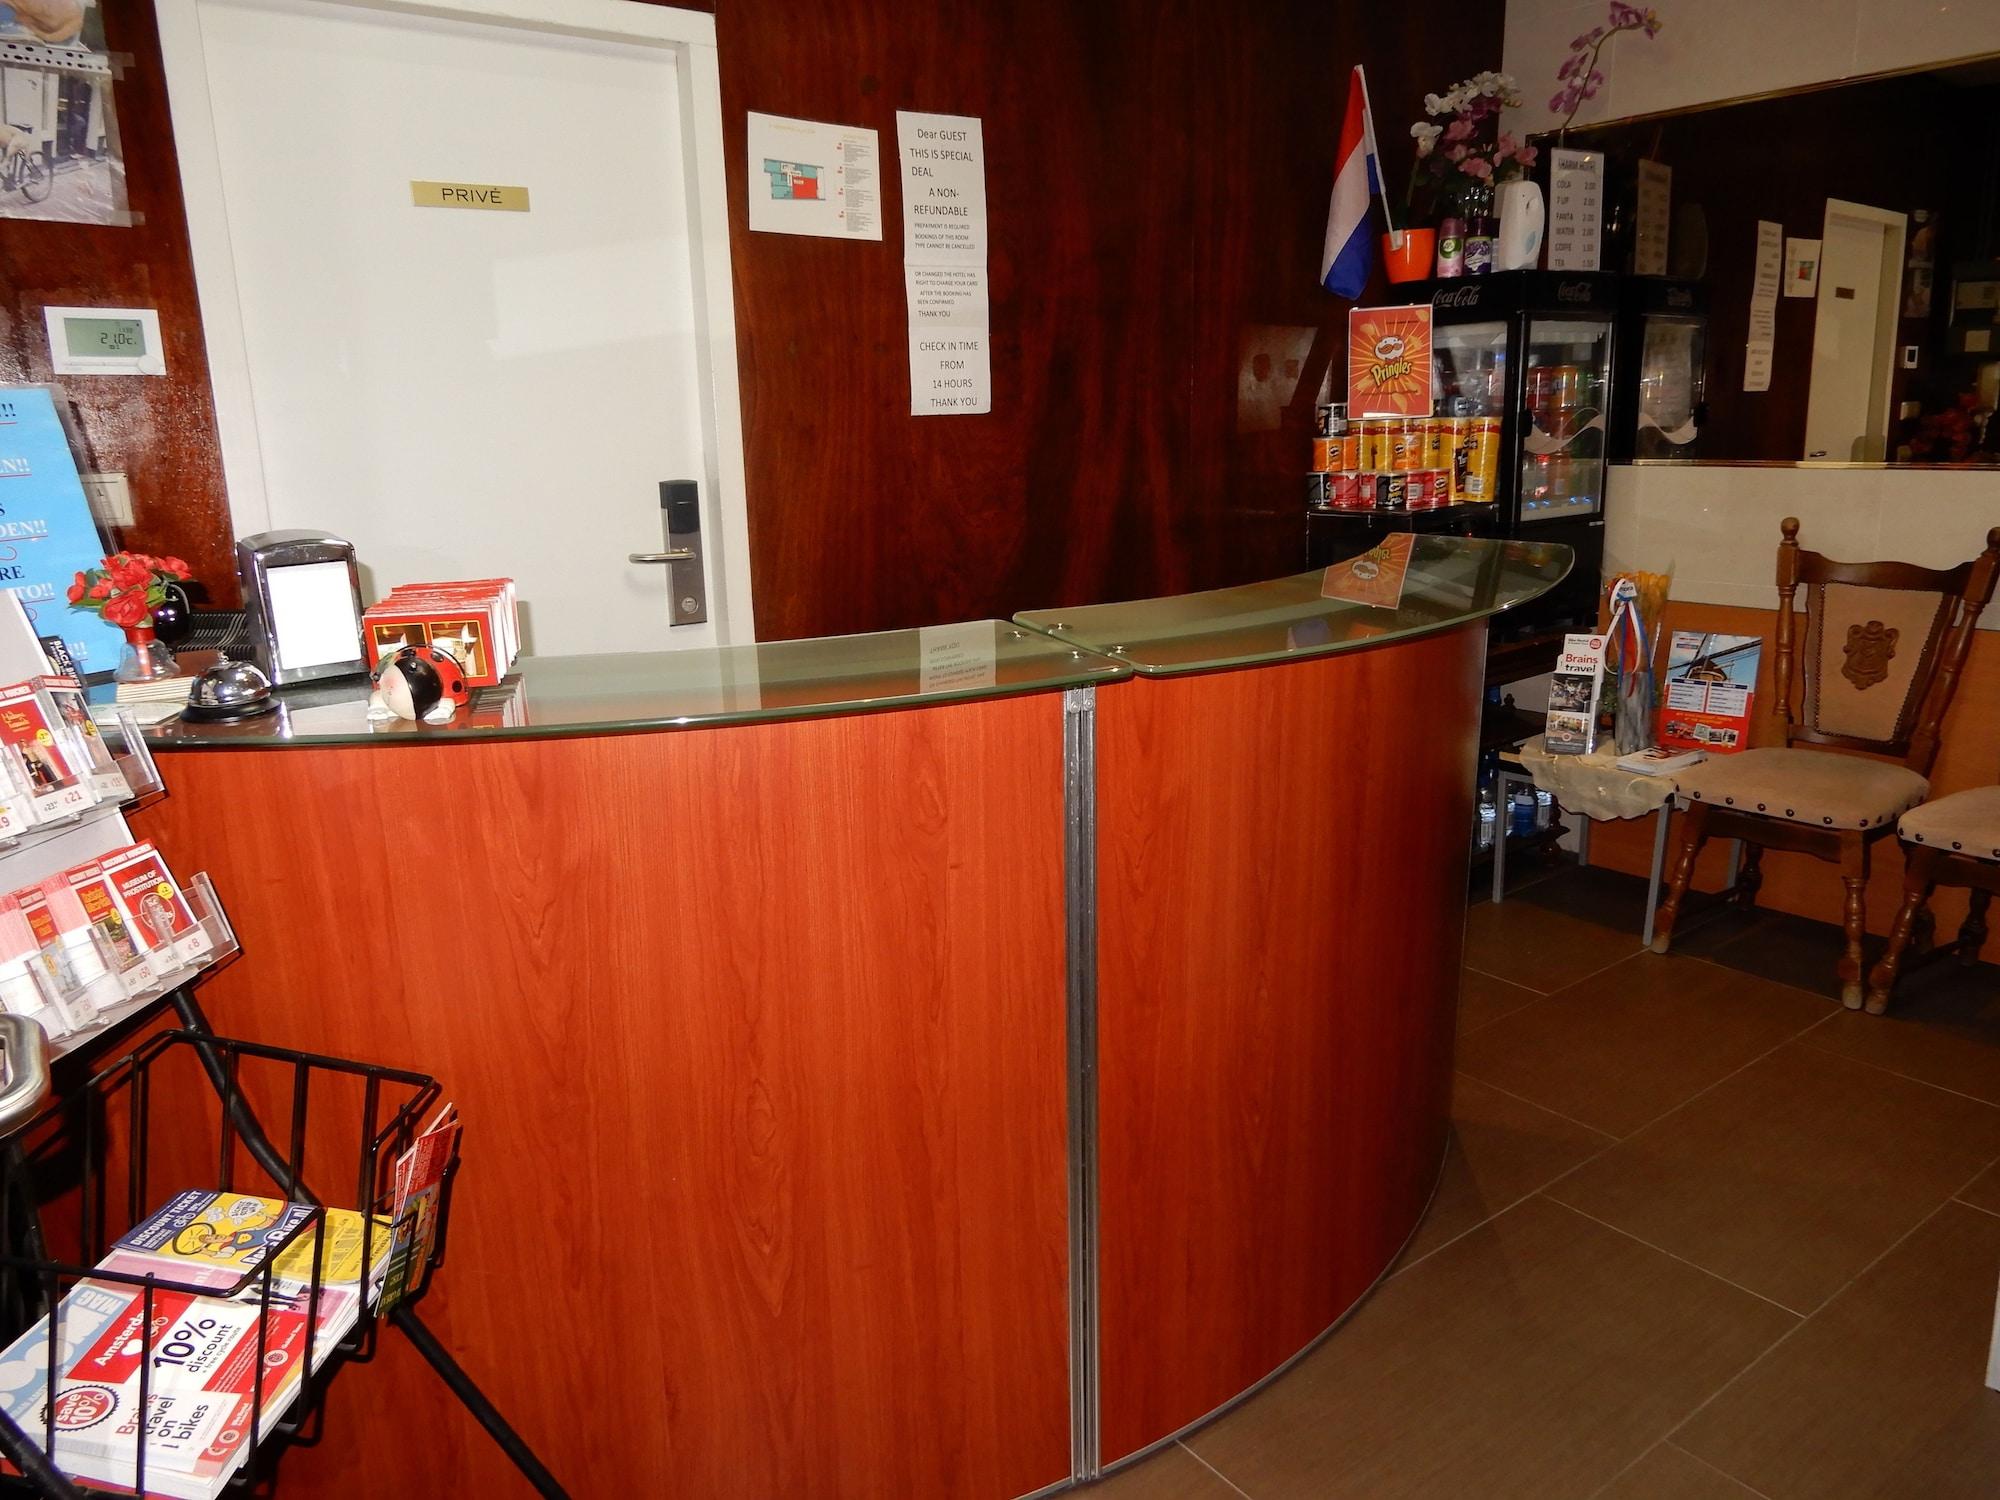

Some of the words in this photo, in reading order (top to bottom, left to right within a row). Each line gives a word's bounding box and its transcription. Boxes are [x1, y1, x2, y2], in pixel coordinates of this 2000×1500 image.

[917, 128, 937, 140] Dear
[940, 130, 967, 141] GUEST
[910, 148, 929, 159] THIS
[931, 150, 939, 159] IS
[941, 151, 973, 162] SPECIAL
[911, 167, 934, 177] DEAL
[929, 188, 935, 197] A
[937, 188, 960, 198] NON-
[914, 205, 968, 216] REFUNDABLE
[918, 310, 938, 318] THANK
[920, 342, 946, 351] CHECK
[948, 342, 957, 351] IN
[959, 341, 979, 351] TIME
[940, 360, 965, 369] FROM
[1371, 358, 1412, 387] Pringles
[932, 380, 942, 389] 14
[944, 379, 973, 388] HOURS
[931, 398, 958, 407] THANK
[960, 397, 978, 406] YOU
[1566, 654, 1598, 663] Brains
[1566, 664, 1596, 672] travel
[130, 1209, 174, 1246] DISCOUNT
[171, 1190, 202, 1216] TICKET
[153, 1319, 217, 1369] 10%
[187, 1324, 233, 1373] discount
[56, 1393, 82, 1422] save
[70, 1392, 106, 1424] 10%
[177, 1404, 209, 1440] bikes
[158, 1420, 178, 1438] on
